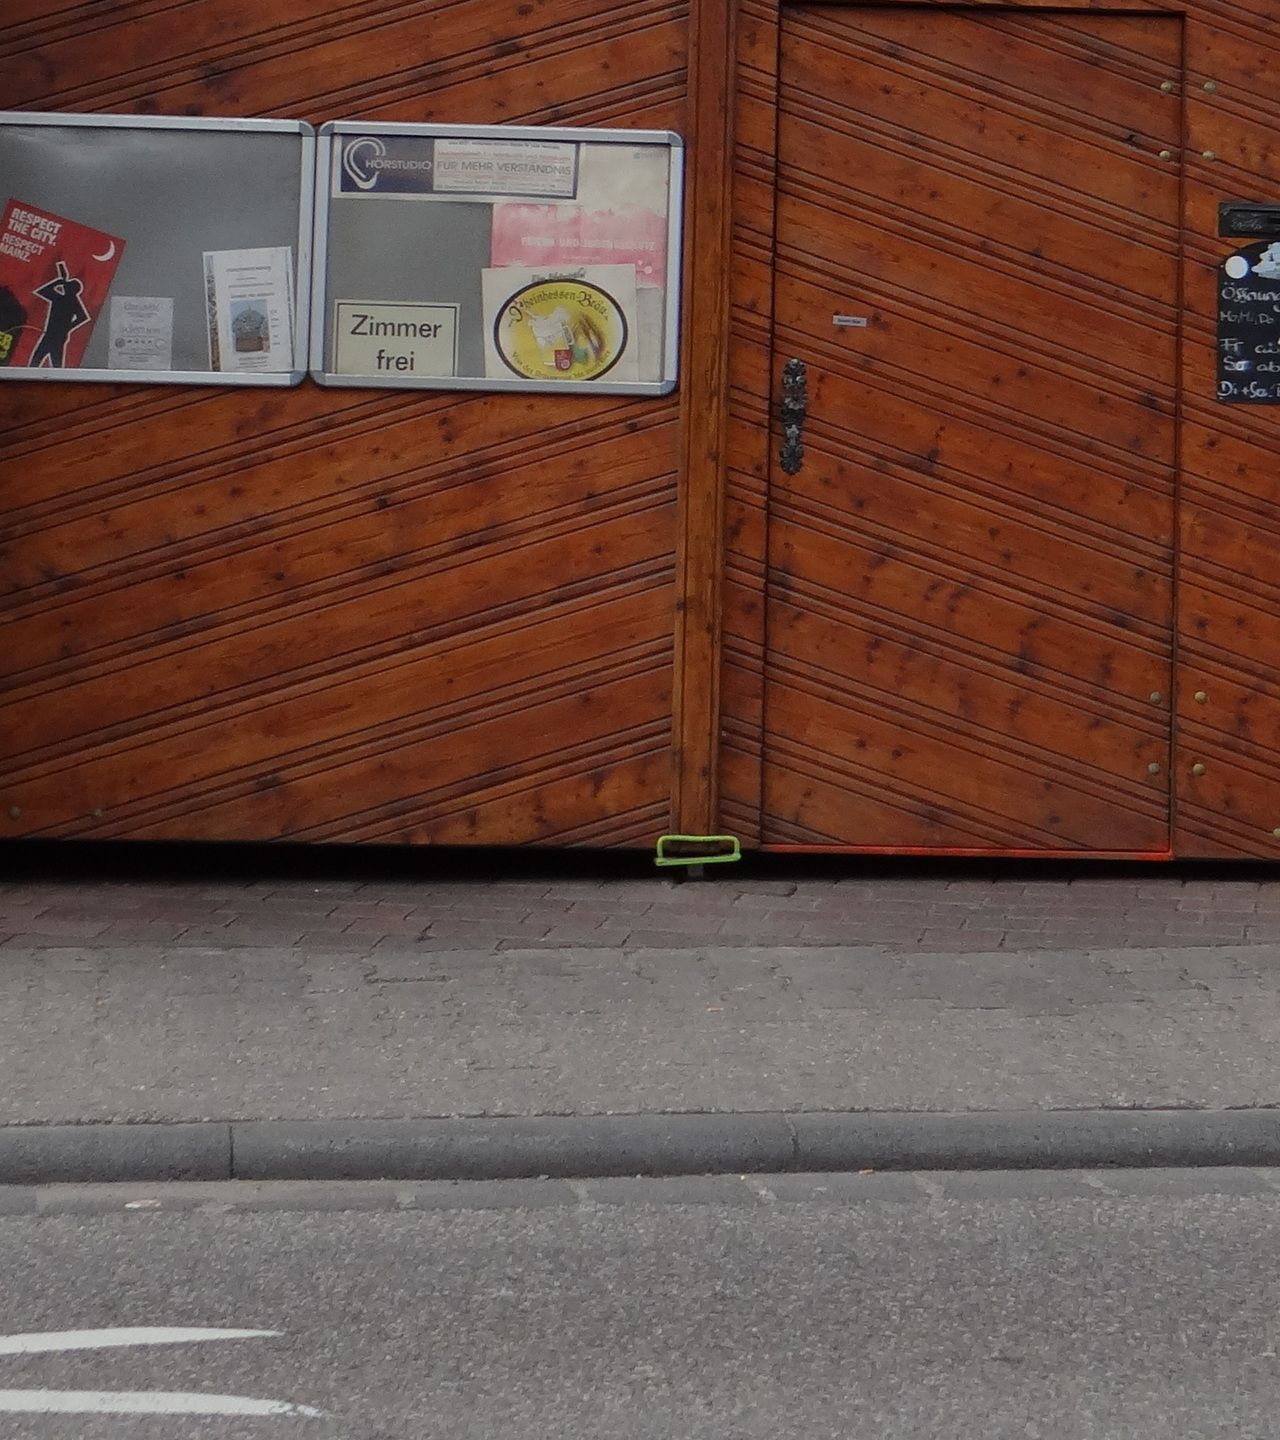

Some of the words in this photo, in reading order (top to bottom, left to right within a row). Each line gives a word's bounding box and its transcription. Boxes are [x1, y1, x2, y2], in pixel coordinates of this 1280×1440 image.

[460, 160, 494, 172] MEHR
[7, 218, 29, 237] THE
[30, 227, 57, 247] CITY.
[10, 207, 63, 234] RESPECT
[1, 233, 45, 257] RESPECT
[350, 313, 442, 339] Zimmer
[376, 348, 415, 372] frei
